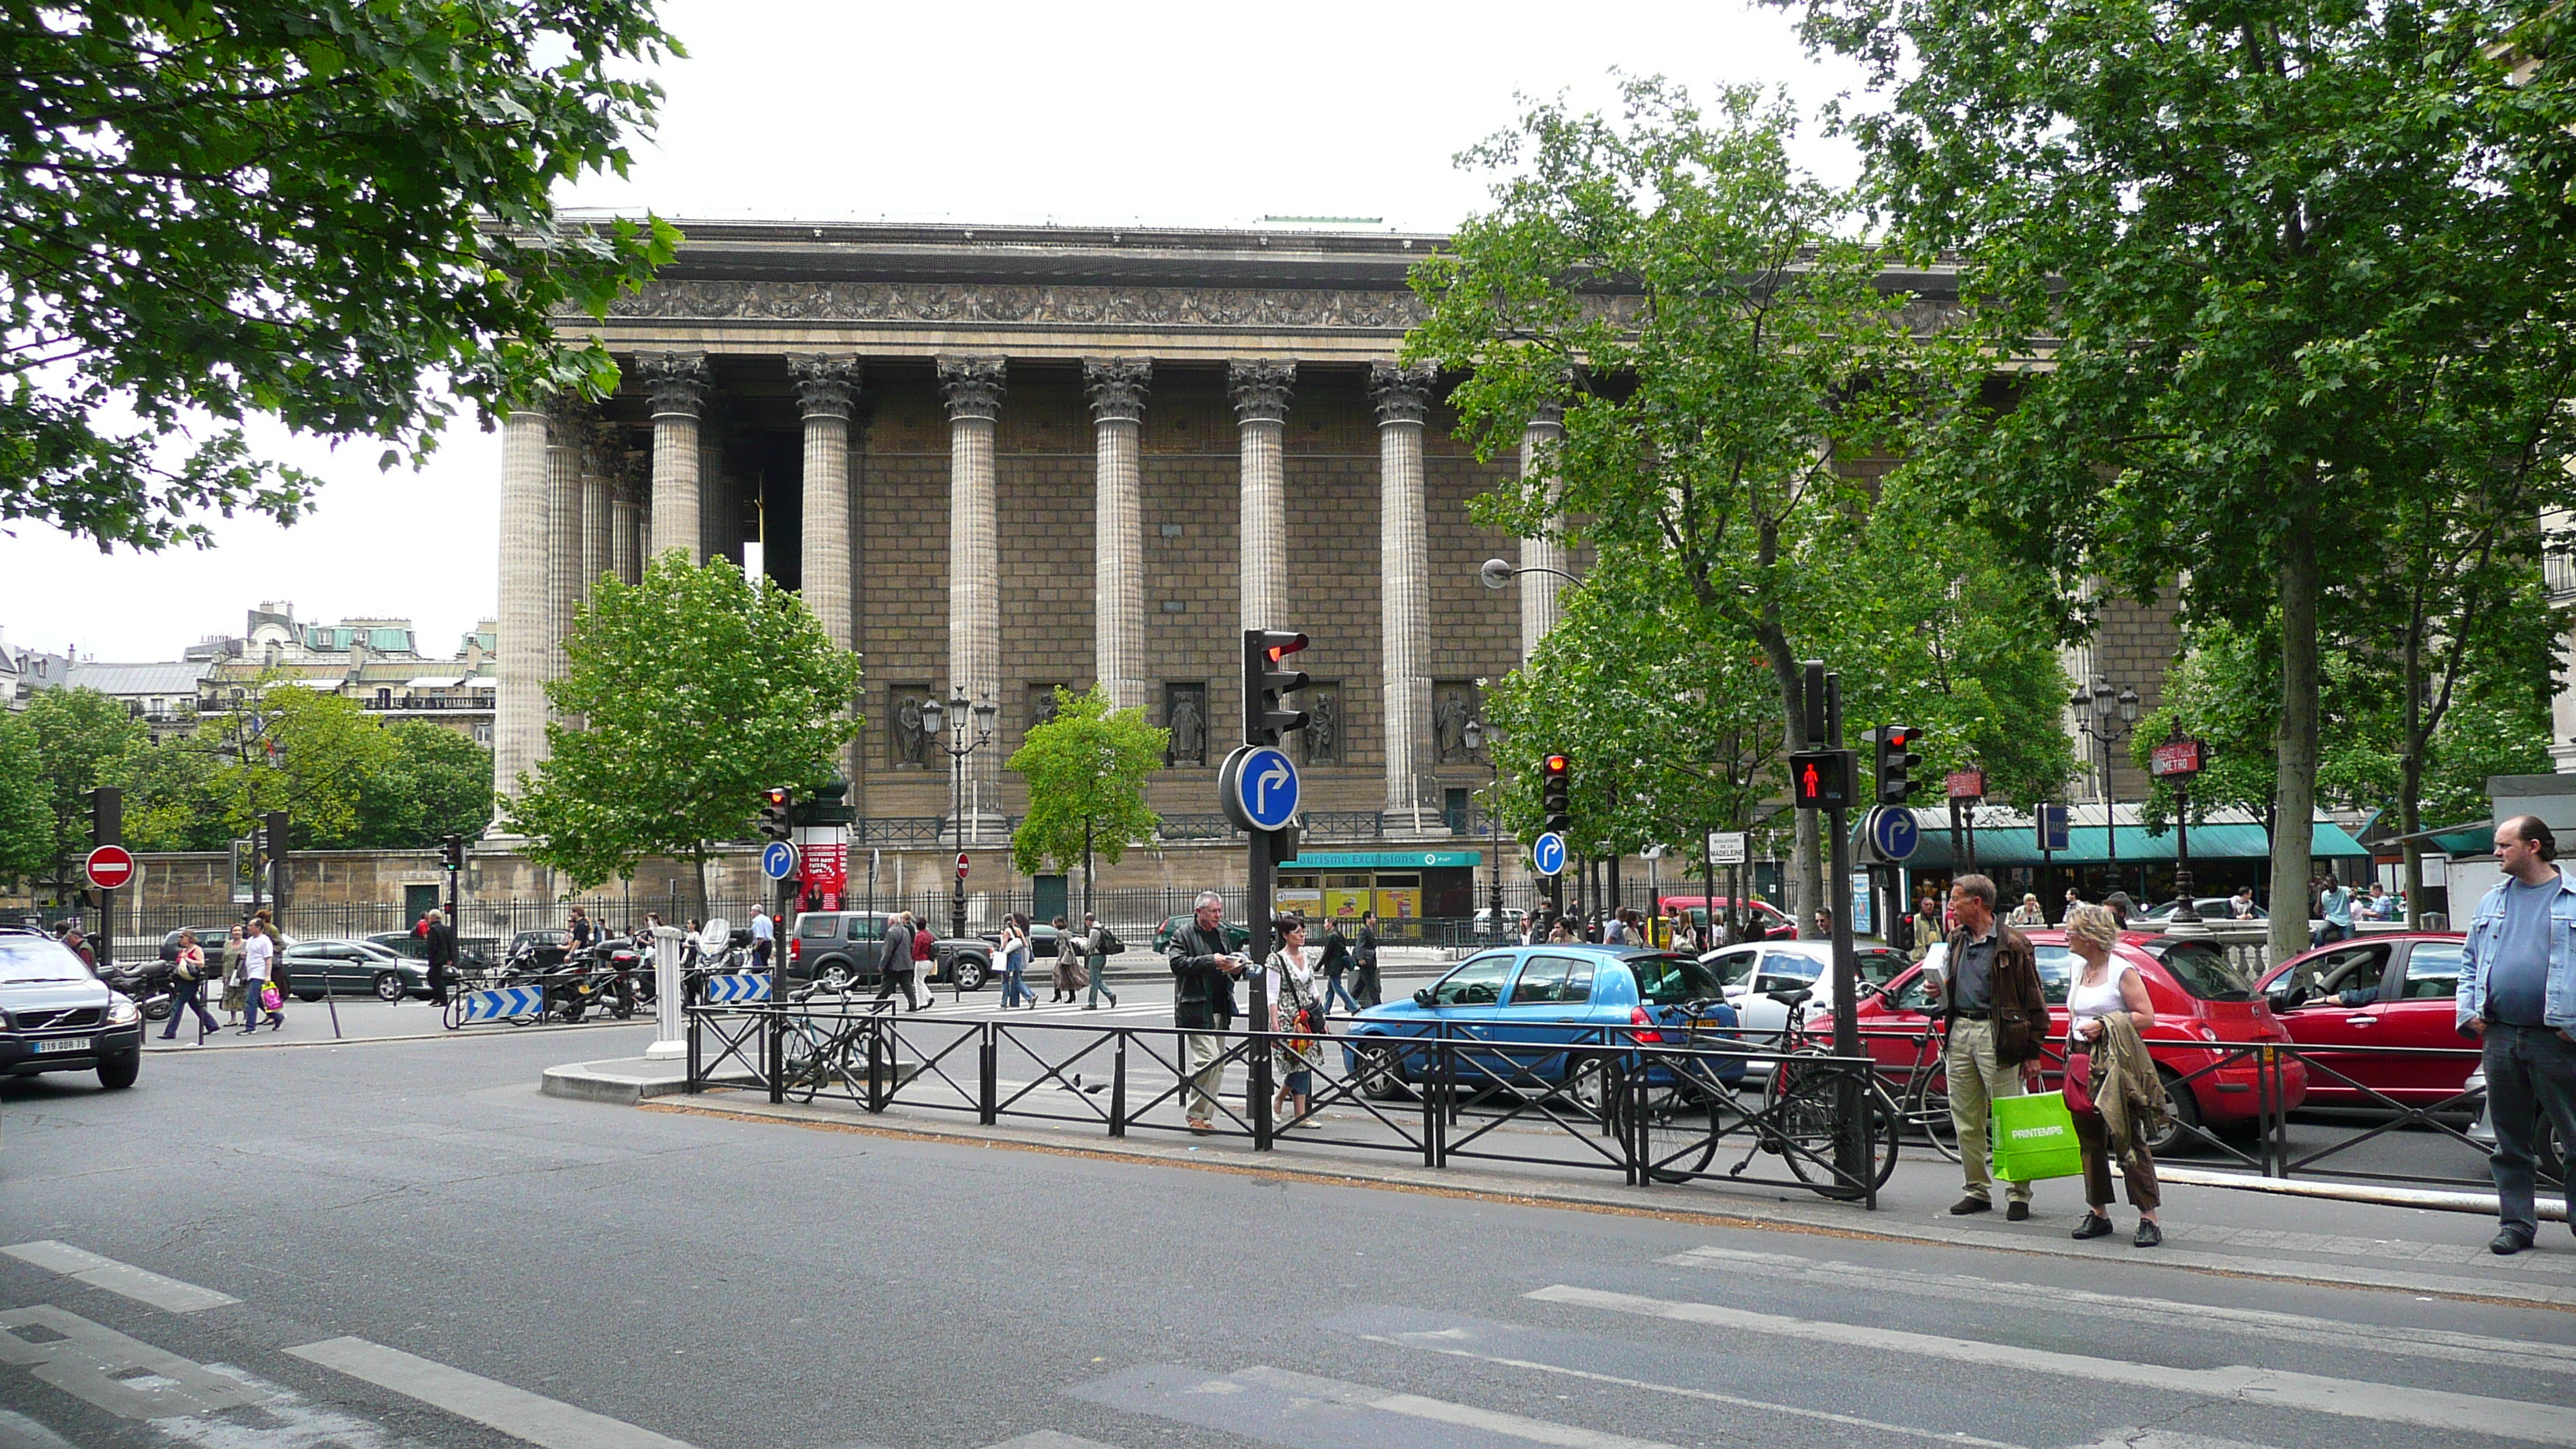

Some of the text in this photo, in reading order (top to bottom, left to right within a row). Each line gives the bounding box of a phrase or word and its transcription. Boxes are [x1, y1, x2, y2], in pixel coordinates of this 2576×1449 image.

[2163, 758, 2187, 771] METRO
[2049, 820, 2066, 834] TAXIS
[1352, 853, 1416, 865] Excursions
[41, 1041, 56, 1051] 919
[77, 1038, 87, 1048] 75
[2011, 1125, 2064, 1139] PRINTEMPS
